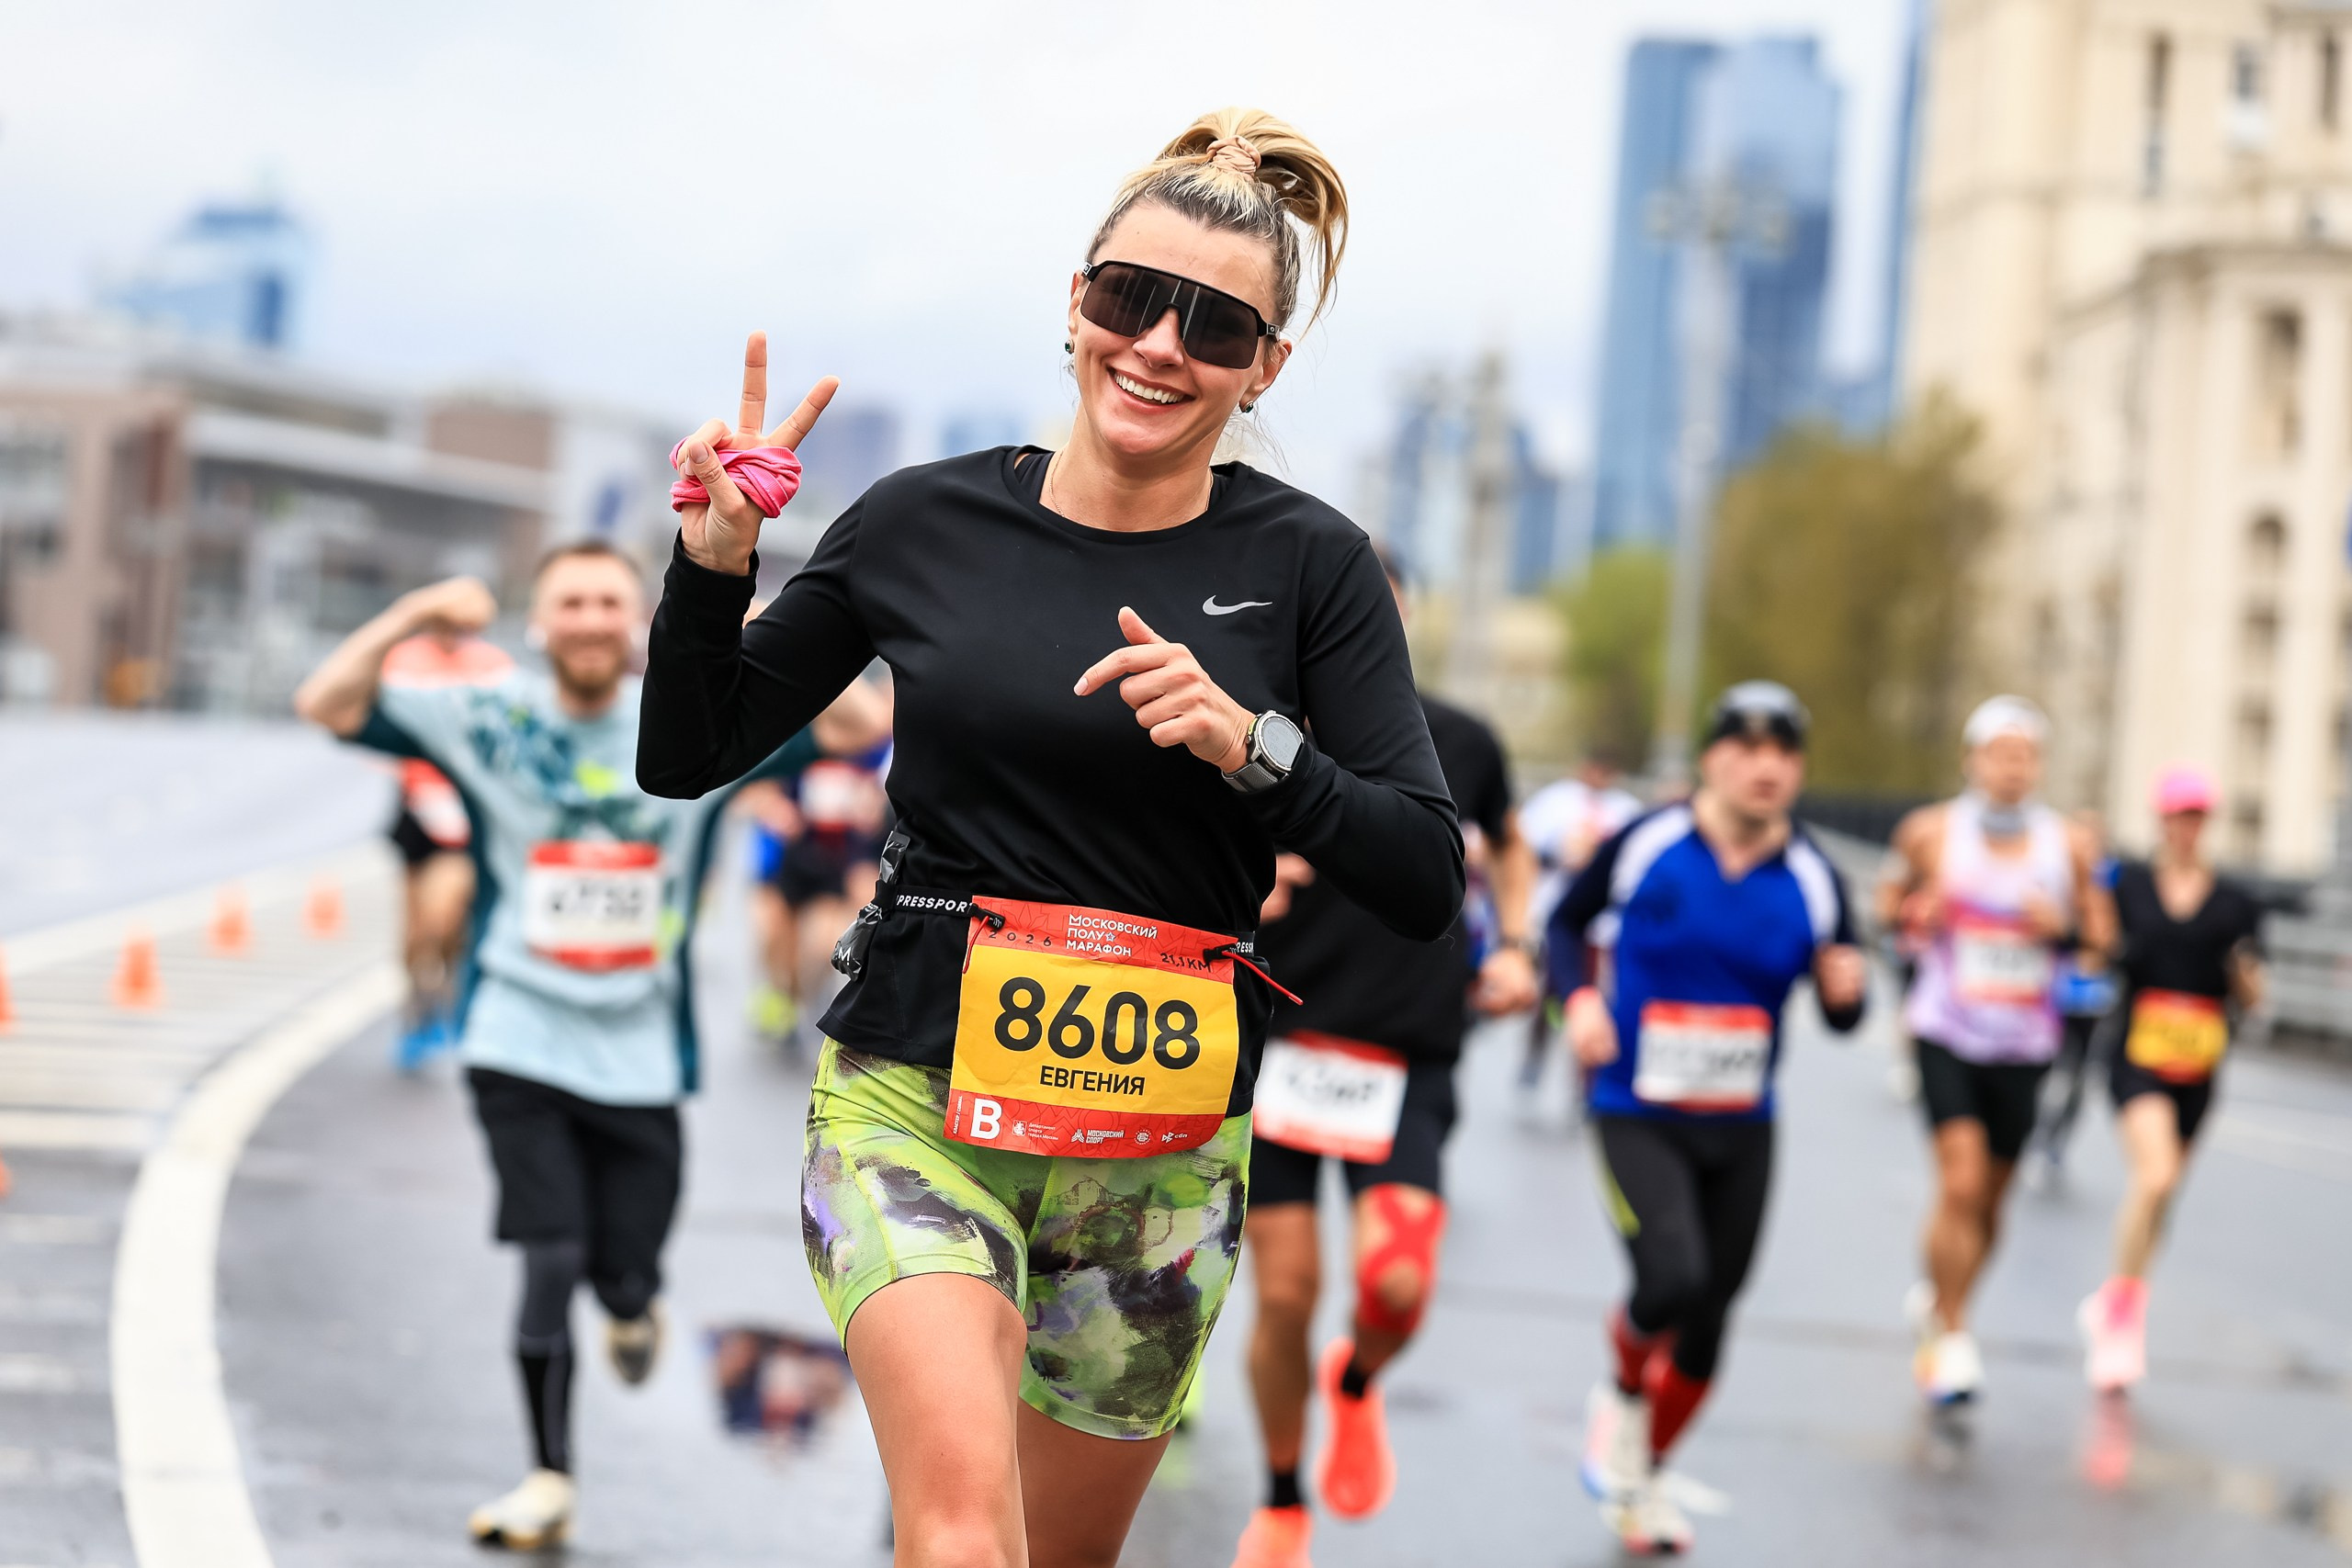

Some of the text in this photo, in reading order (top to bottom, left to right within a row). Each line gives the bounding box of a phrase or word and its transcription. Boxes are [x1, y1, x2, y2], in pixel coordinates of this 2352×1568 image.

[1067, 927, 1105, 941] ПОЛУ
[1069, 913, 1158, 939] МОСКОВСКИЙ
[1066, 940, 1132, 957] МАРАФОН
[994, 976, 1201, 1070] 8608
[1039, 1065, 1146, 1096] ЕВГЕНИЯ
[1085, 1136, 1104, 1145] СПОРТ
[1087, 1129, 1125, 1138] МОСКОВСКИЙ
